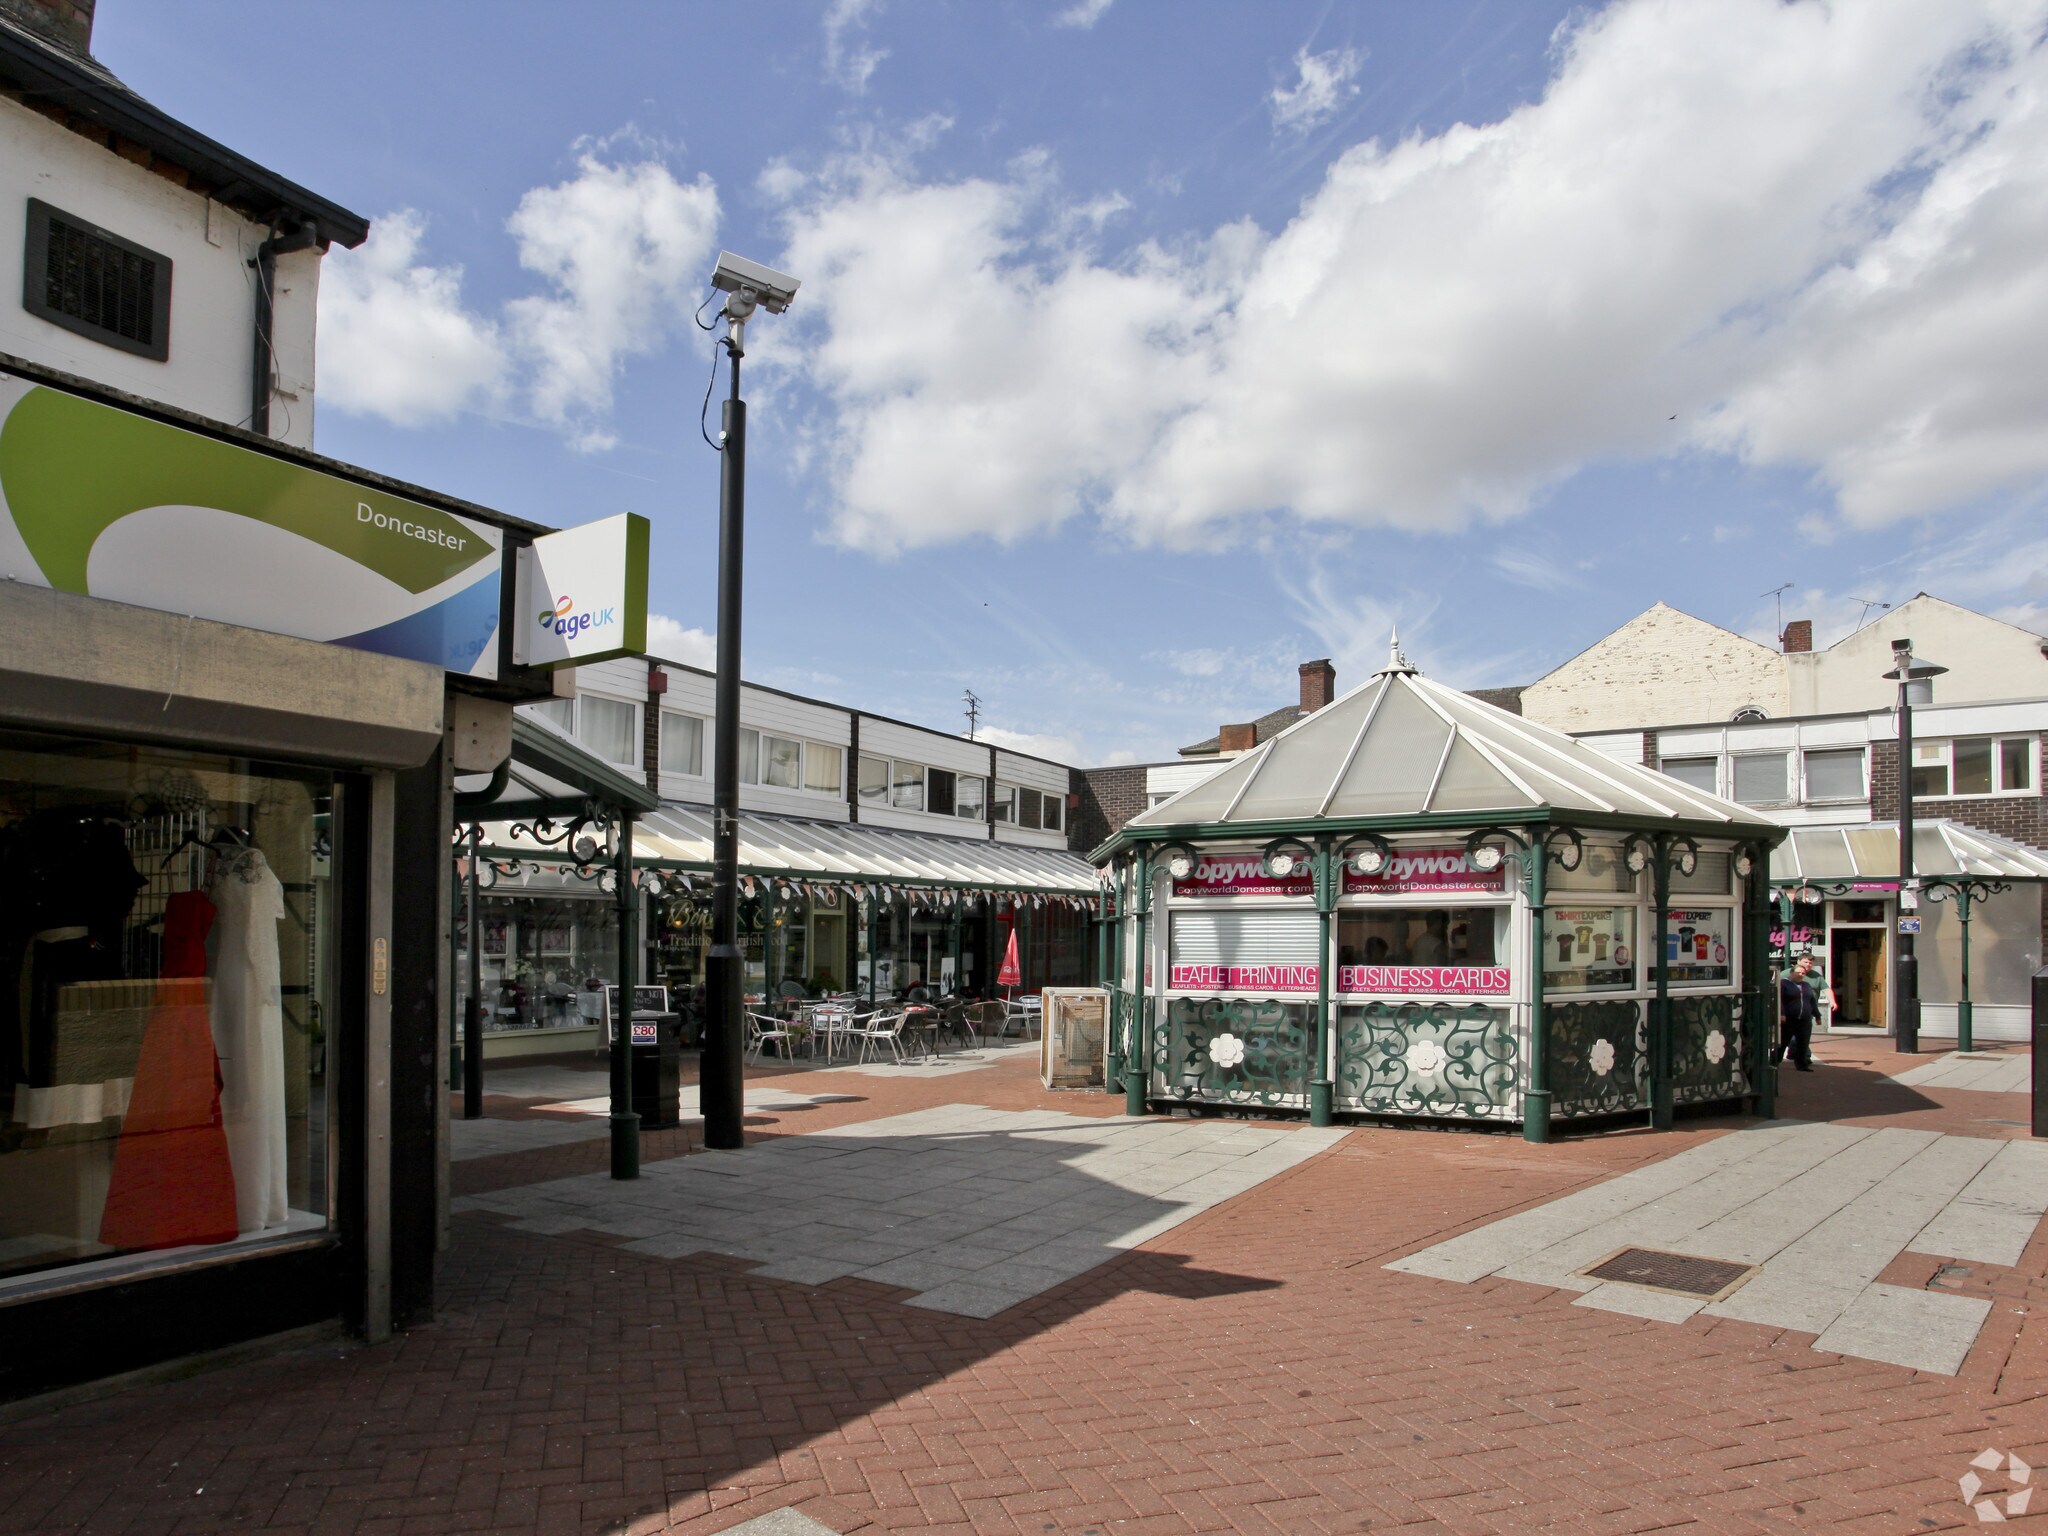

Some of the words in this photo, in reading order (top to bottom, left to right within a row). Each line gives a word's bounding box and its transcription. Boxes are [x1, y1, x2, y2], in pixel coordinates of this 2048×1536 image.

[356, 502, 467, 551] Doncaster
[1177, 885, 1312, 895] CopyworldDoncaster.com
[1347, 881, 1501, 893] CopyworldDoncaster.com
[1171, 966, 1233, 984] LEAFLET
[1239, 966, 1317, 985] PRINTING
[1342, 968, 1434, 987] BUSINESS
[1440, 969, 1507, 988] CARDS
[633, 1025, 656, 1036] £80
